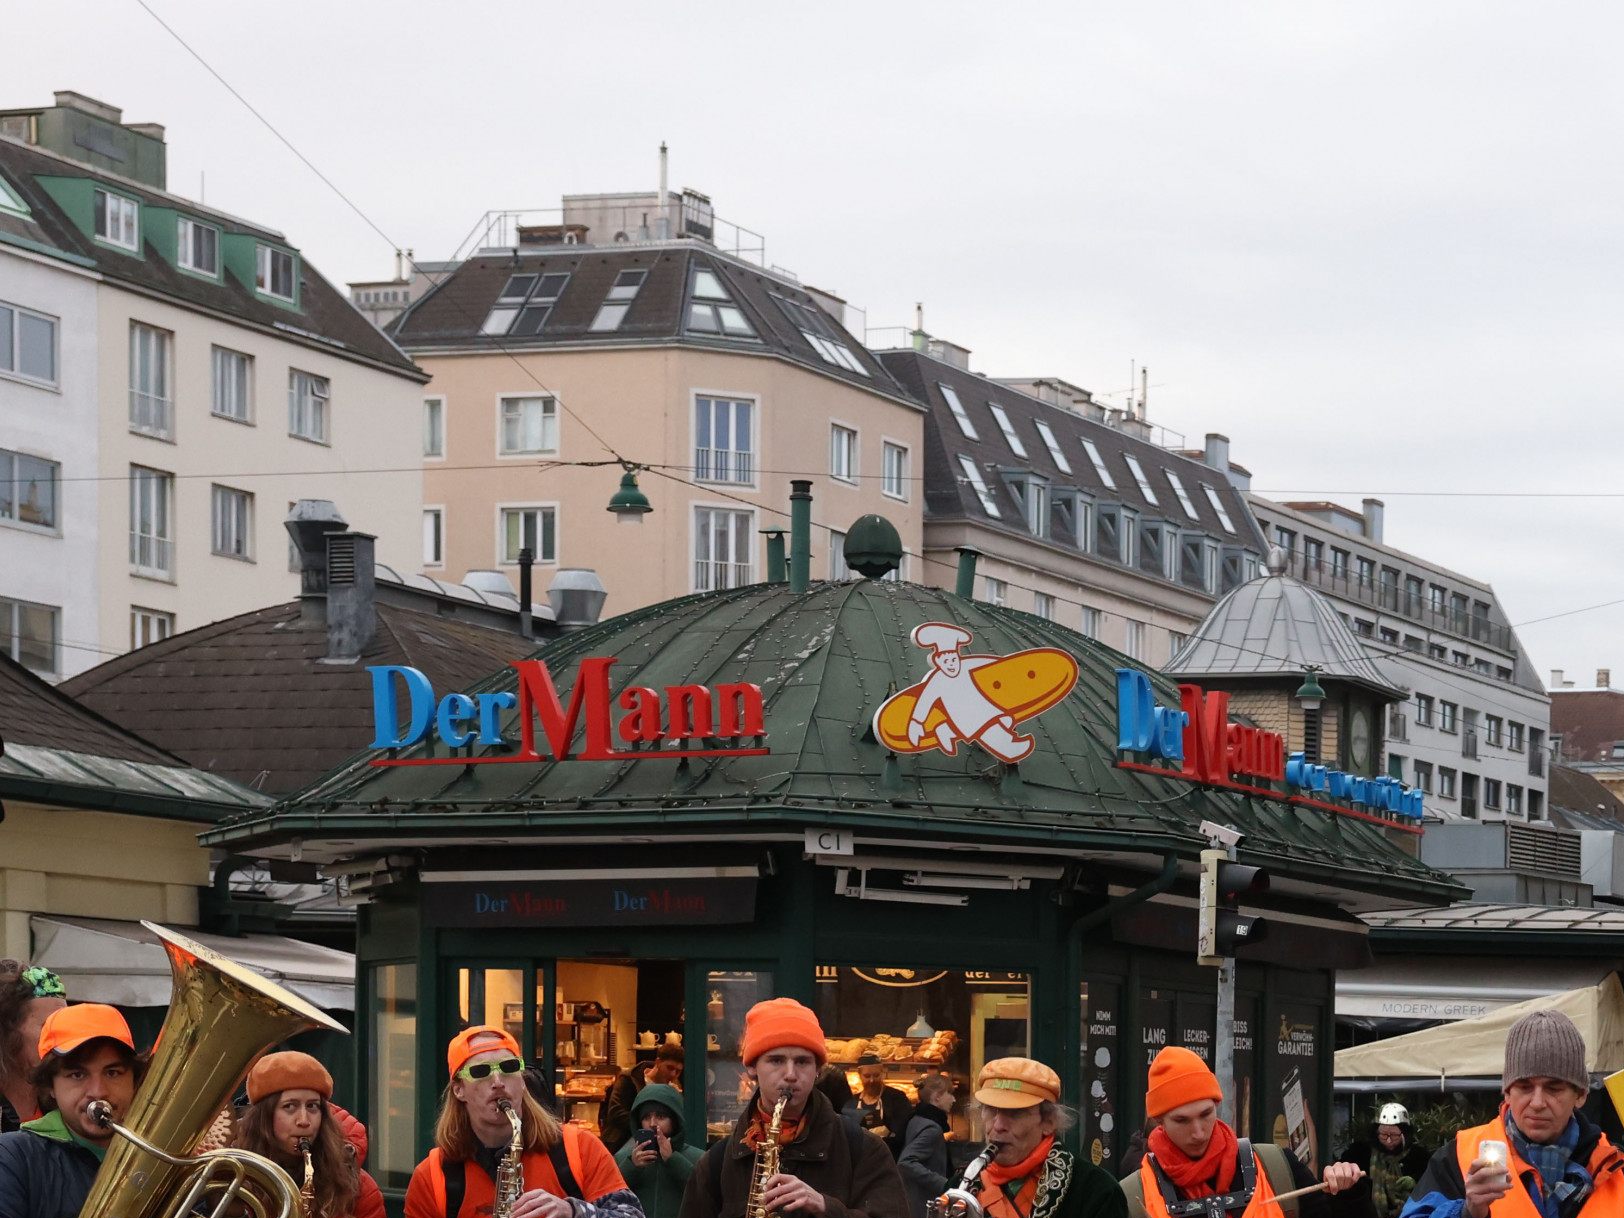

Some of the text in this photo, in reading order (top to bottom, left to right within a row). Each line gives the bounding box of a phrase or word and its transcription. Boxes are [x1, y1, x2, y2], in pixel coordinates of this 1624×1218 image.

[1382, 1003, 1487, 1016] MODERN GREEK
[1143, 1027, 1166, 1045] LANG
[1183, 1028, 1211, 1044] LECKER-
[1278, 1041, 1313, 1056] GARANTIE!
